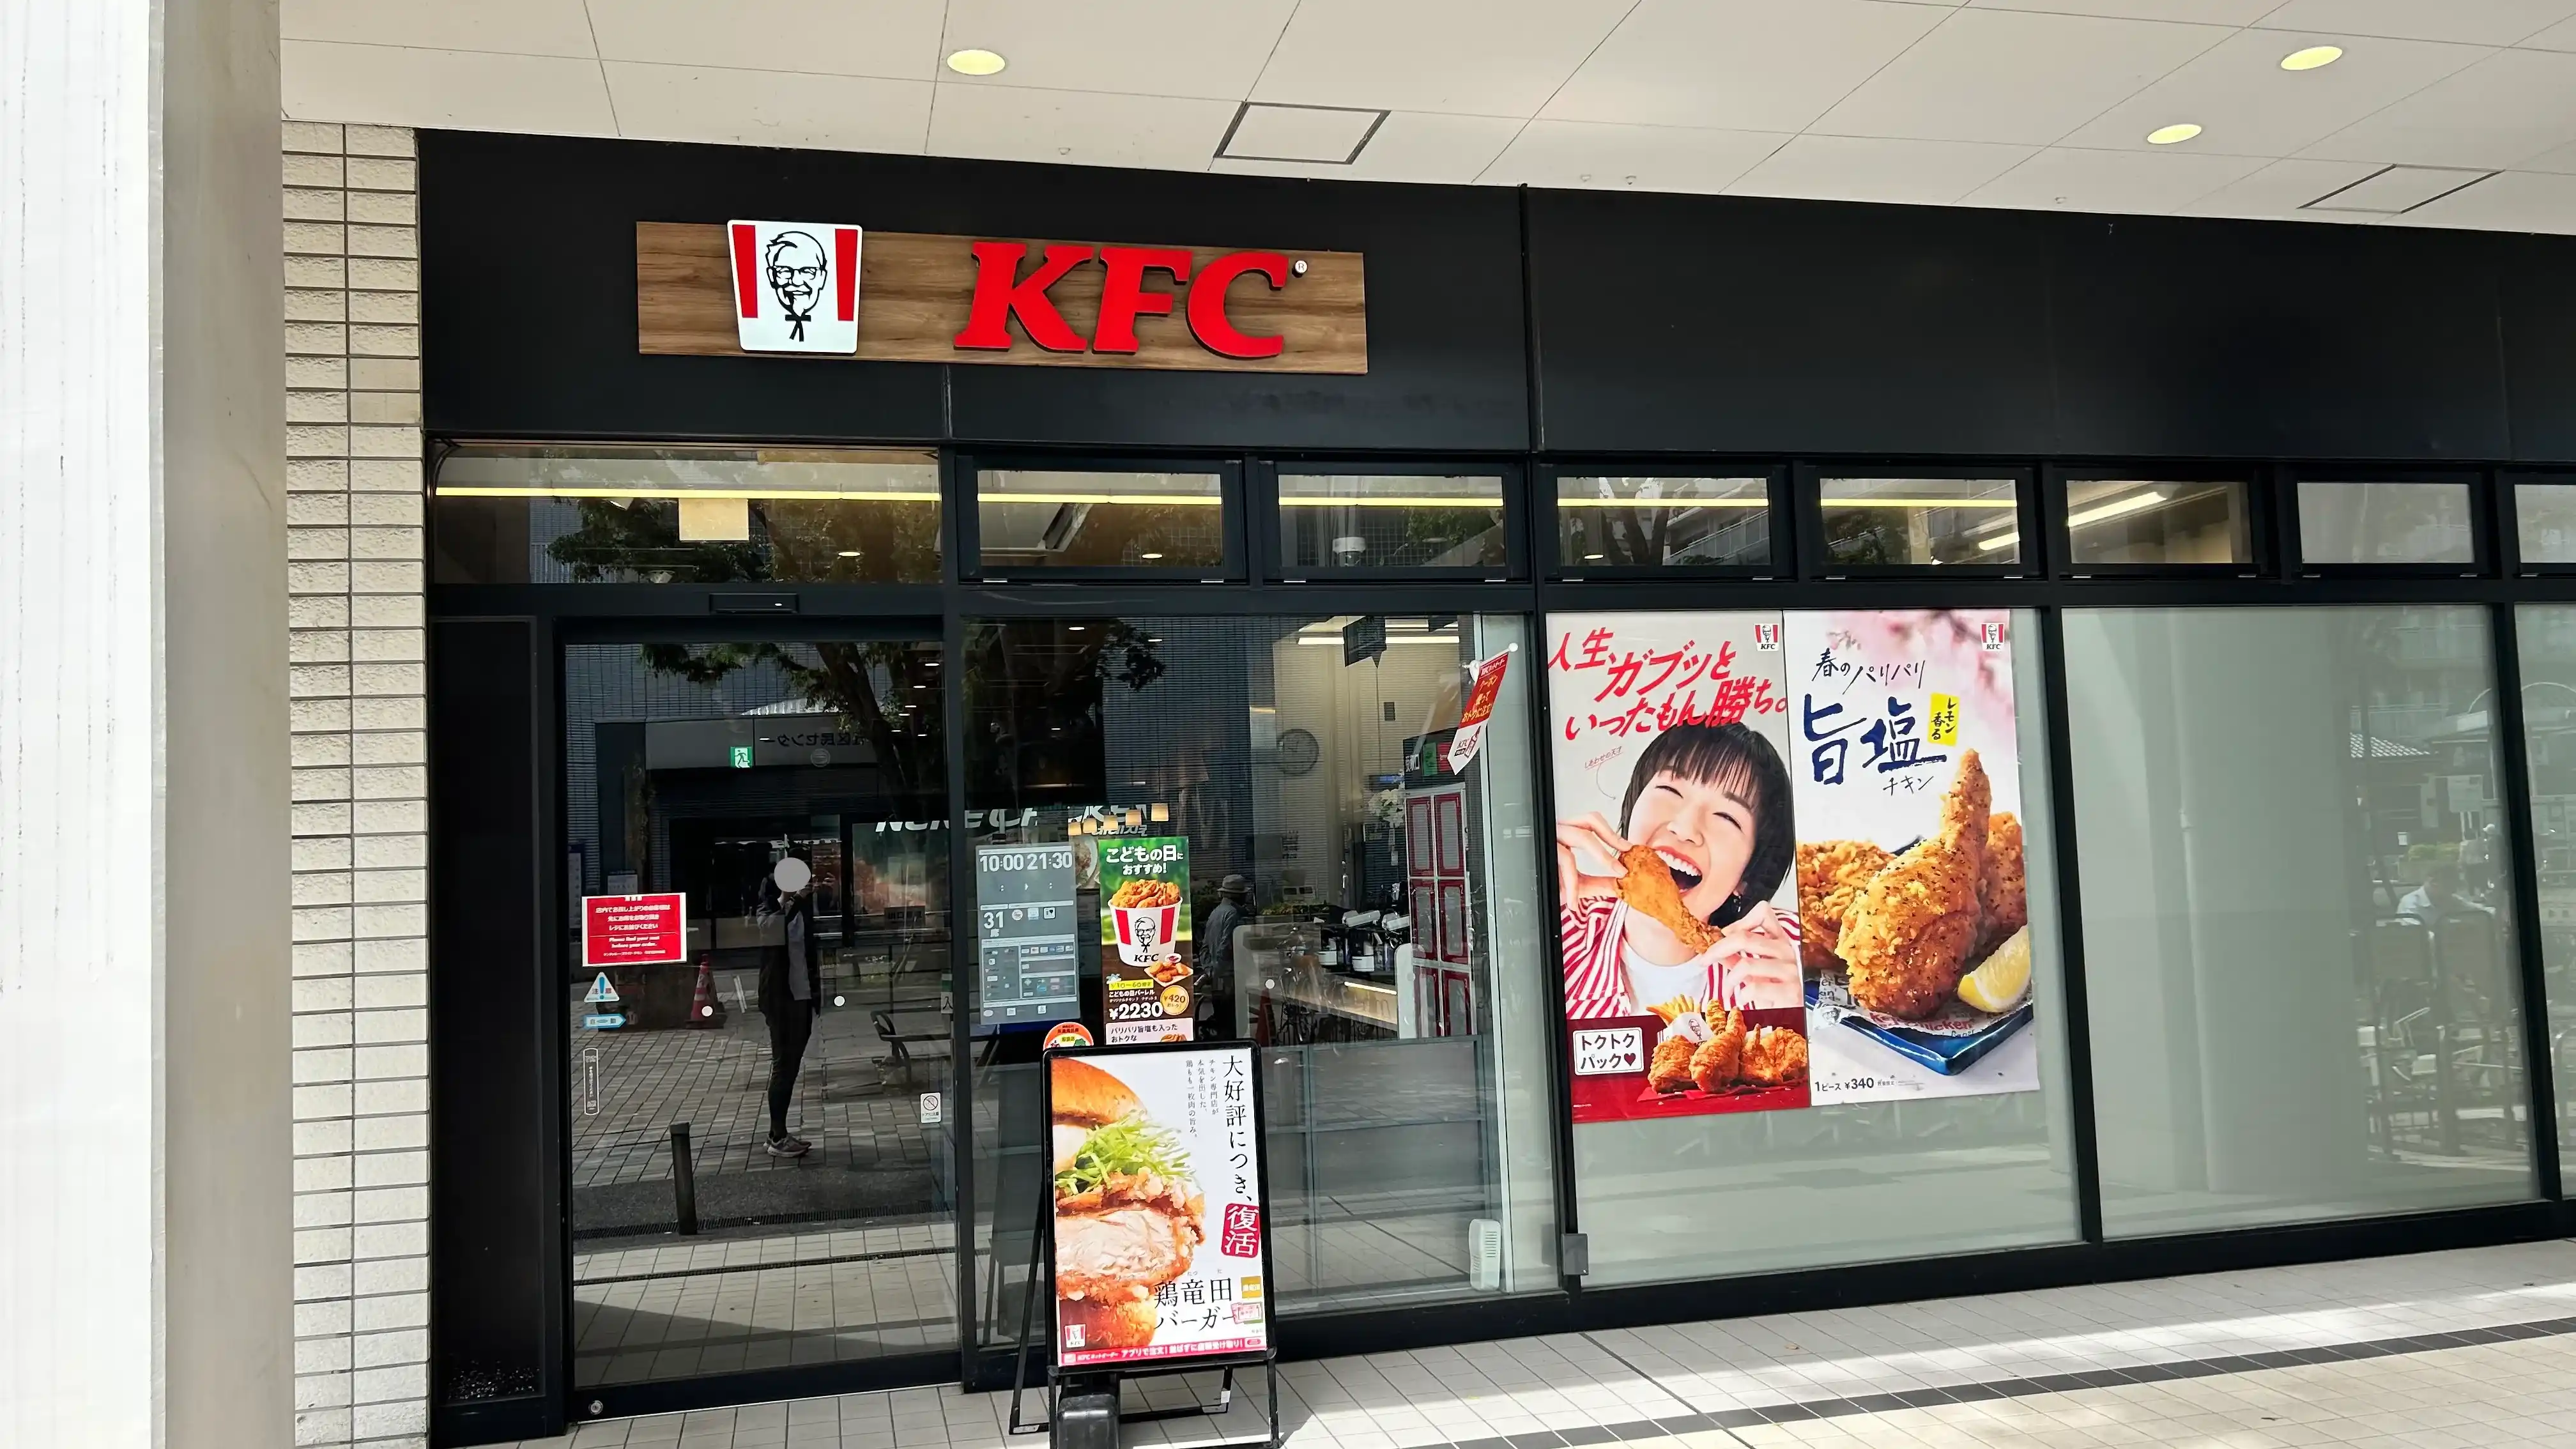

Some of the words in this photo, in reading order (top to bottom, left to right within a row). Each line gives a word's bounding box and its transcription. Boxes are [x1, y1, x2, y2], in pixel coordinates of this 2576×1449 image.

[953, 240, 1289, 359] KFC
[1812, 648, 1926, 695] 春のパリパリ
[1565, 675, 1788, 740] いったもん勝ち。
[1945, 698, 1958, 734] レモン
[1931, 712, 1945, 740] 香る
[1803, 693, 1947, 785] 旨塩
[1882, 776, 1935, 797] チキン
[979, 854, 1024, 872] 10:00
[1027, 852, 1073, 870] 21:30
[1106, 845, 1184, 863] こどもの日に
[1123, 863, 1167, 875] おすすめ!
[983, 911, 1004, 929] 31
[1133, 953, 1159, 963] KFC
[1163, 994, 1186, 1003] ¥420
[1109, 1001, 1163, 1020] ¥2230
[1580, 1032, 1636, 1052] トクトク
[1580, 1052, 1621, 1070] パック
[1209, 1059, 1219, 1115] チキン専門店が
[1814, 1080, 1842, 1092] 1ピース
[1844, 1077, 1874, 1090] ¥340
[1223, 1055, 1253, 1202] 大好評につき、
[1224, 1205, 1259, 1256] 復活
[1154, 1277, 1232, 1308] 鶏竜田
[1154, 1305, 1235, 1331] バーガー
